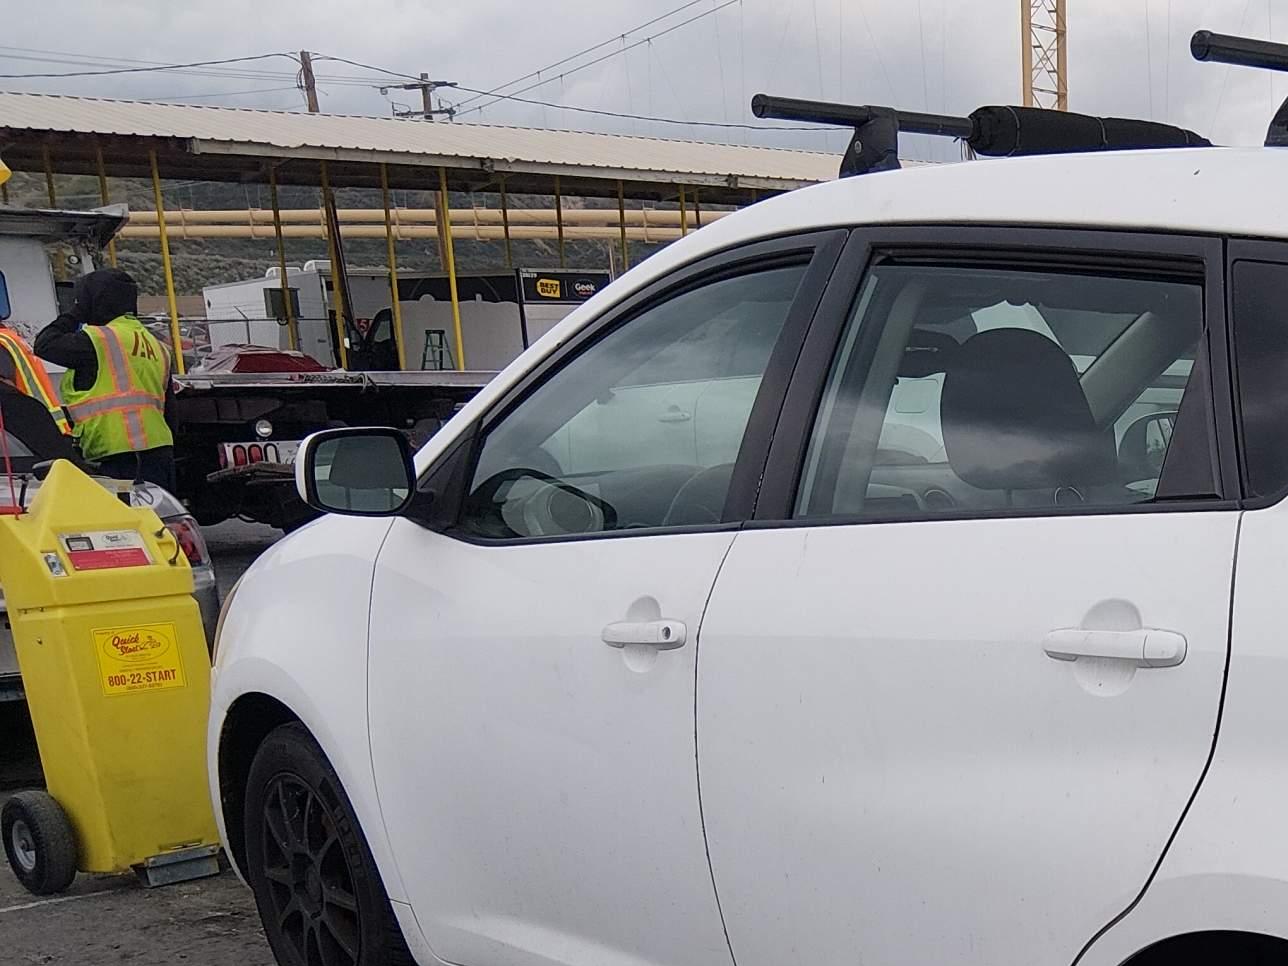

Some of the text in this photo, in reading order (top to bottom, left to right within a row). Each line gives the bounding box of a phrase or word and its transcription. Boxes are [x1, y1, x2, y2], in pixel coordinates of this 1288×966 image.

[540, 282, 558, 290] BEST
[575, 283, 596, 291] Geek
[112, 633, 140, 650] Quick
[108, 669, 176, 687] 800-22-START
